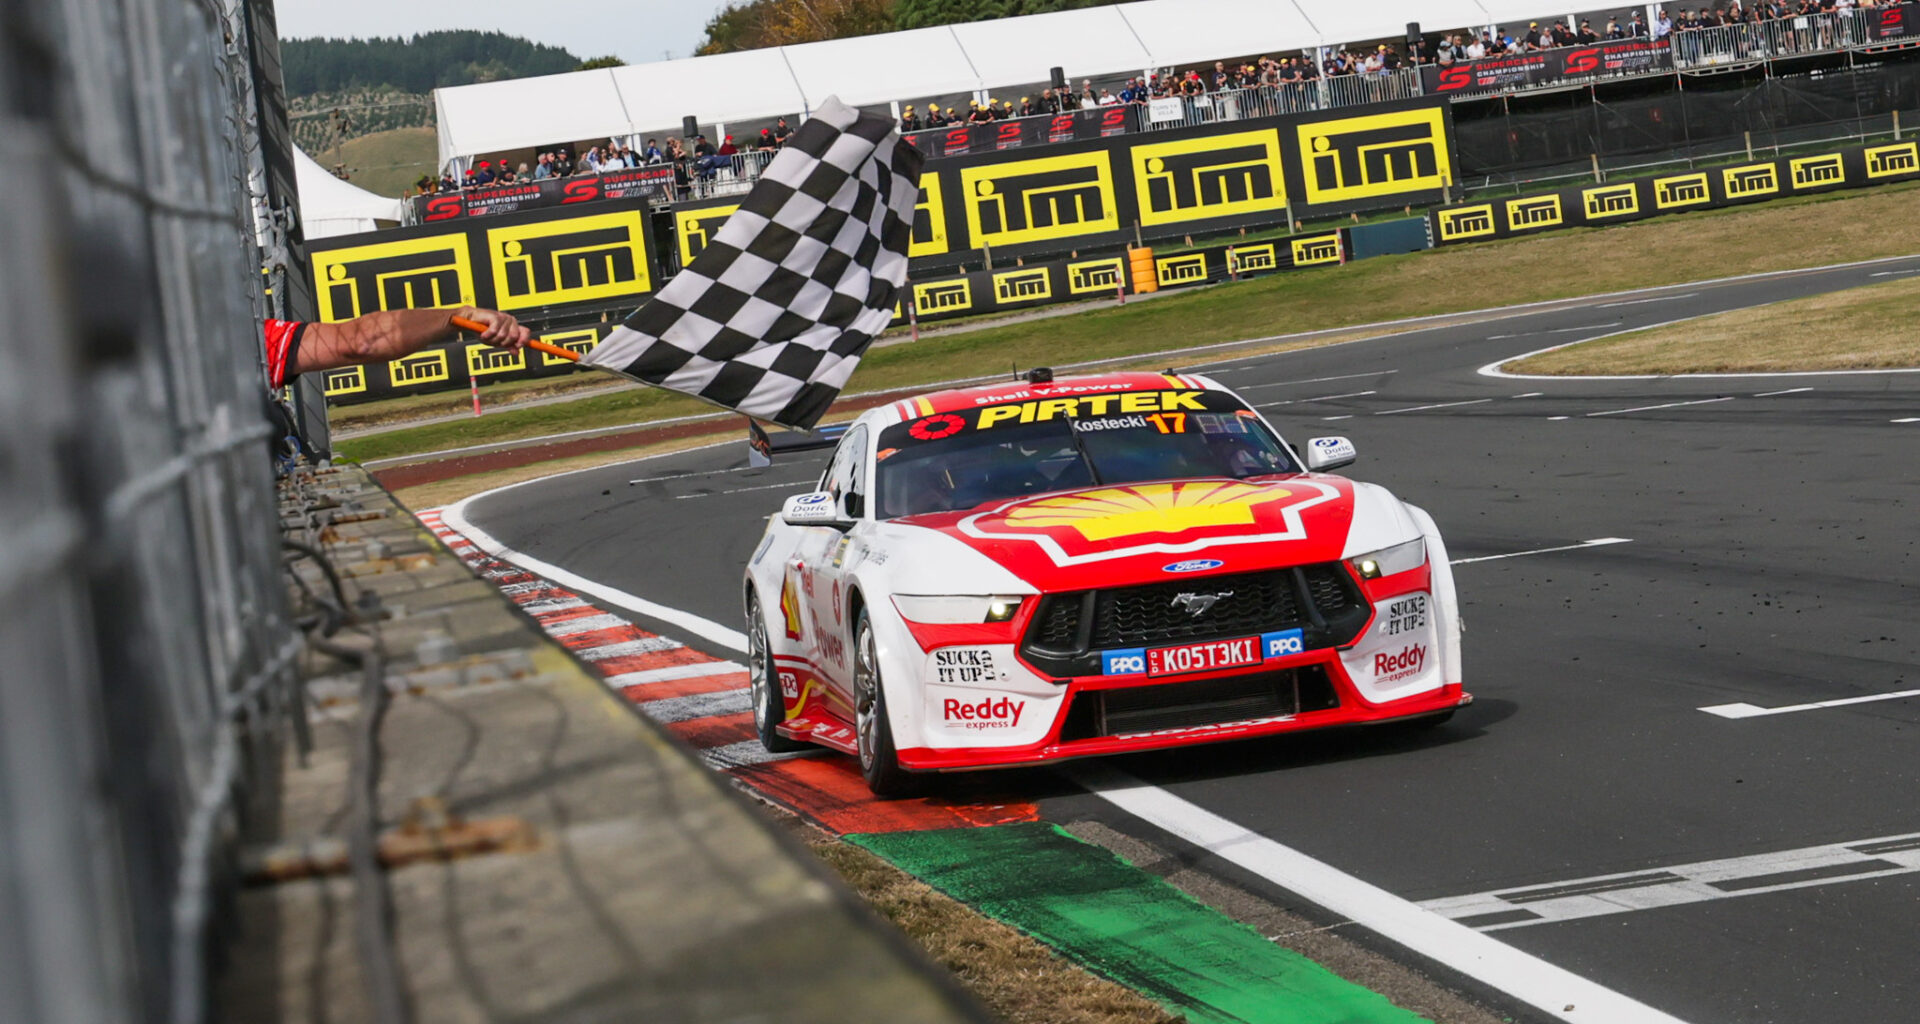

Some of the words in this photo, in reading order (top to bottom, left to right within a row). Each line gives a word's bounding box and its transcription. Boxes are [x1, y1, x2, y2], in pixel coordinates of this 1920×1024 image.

[467, 185, 541, 200] SUPERCARS
[468, 193, 541, 208] CHAMPIONSHIP
[975, 391, 1030, 405] Shell
[1034, 383, 1132, 395] V-Power
[976, 391, 1207, 430] PIRTEK
[1073, 414, 1147, 432] Kostecki
[1146, 412, 1186, 434] 17
[1390, 597, 1418, 618] SUCK
[1389, 619, 1401, 635] IT
[1404, 614, 1418, 631] UP
[1270, 636, 1302, 656] PPQ
[936, 650, 981, 666] SUCK
[1109, 656, 1145, 674] PPQ
[1374, 643, 1427, 676] Reddy
[938, 668, 955, 682] IT
[959, 667, 982, 682] UP
[1389, 668, 1417, 681] express
[944, 696, 1025, 727] Reddy
[966, 720, 1009, 731] express
